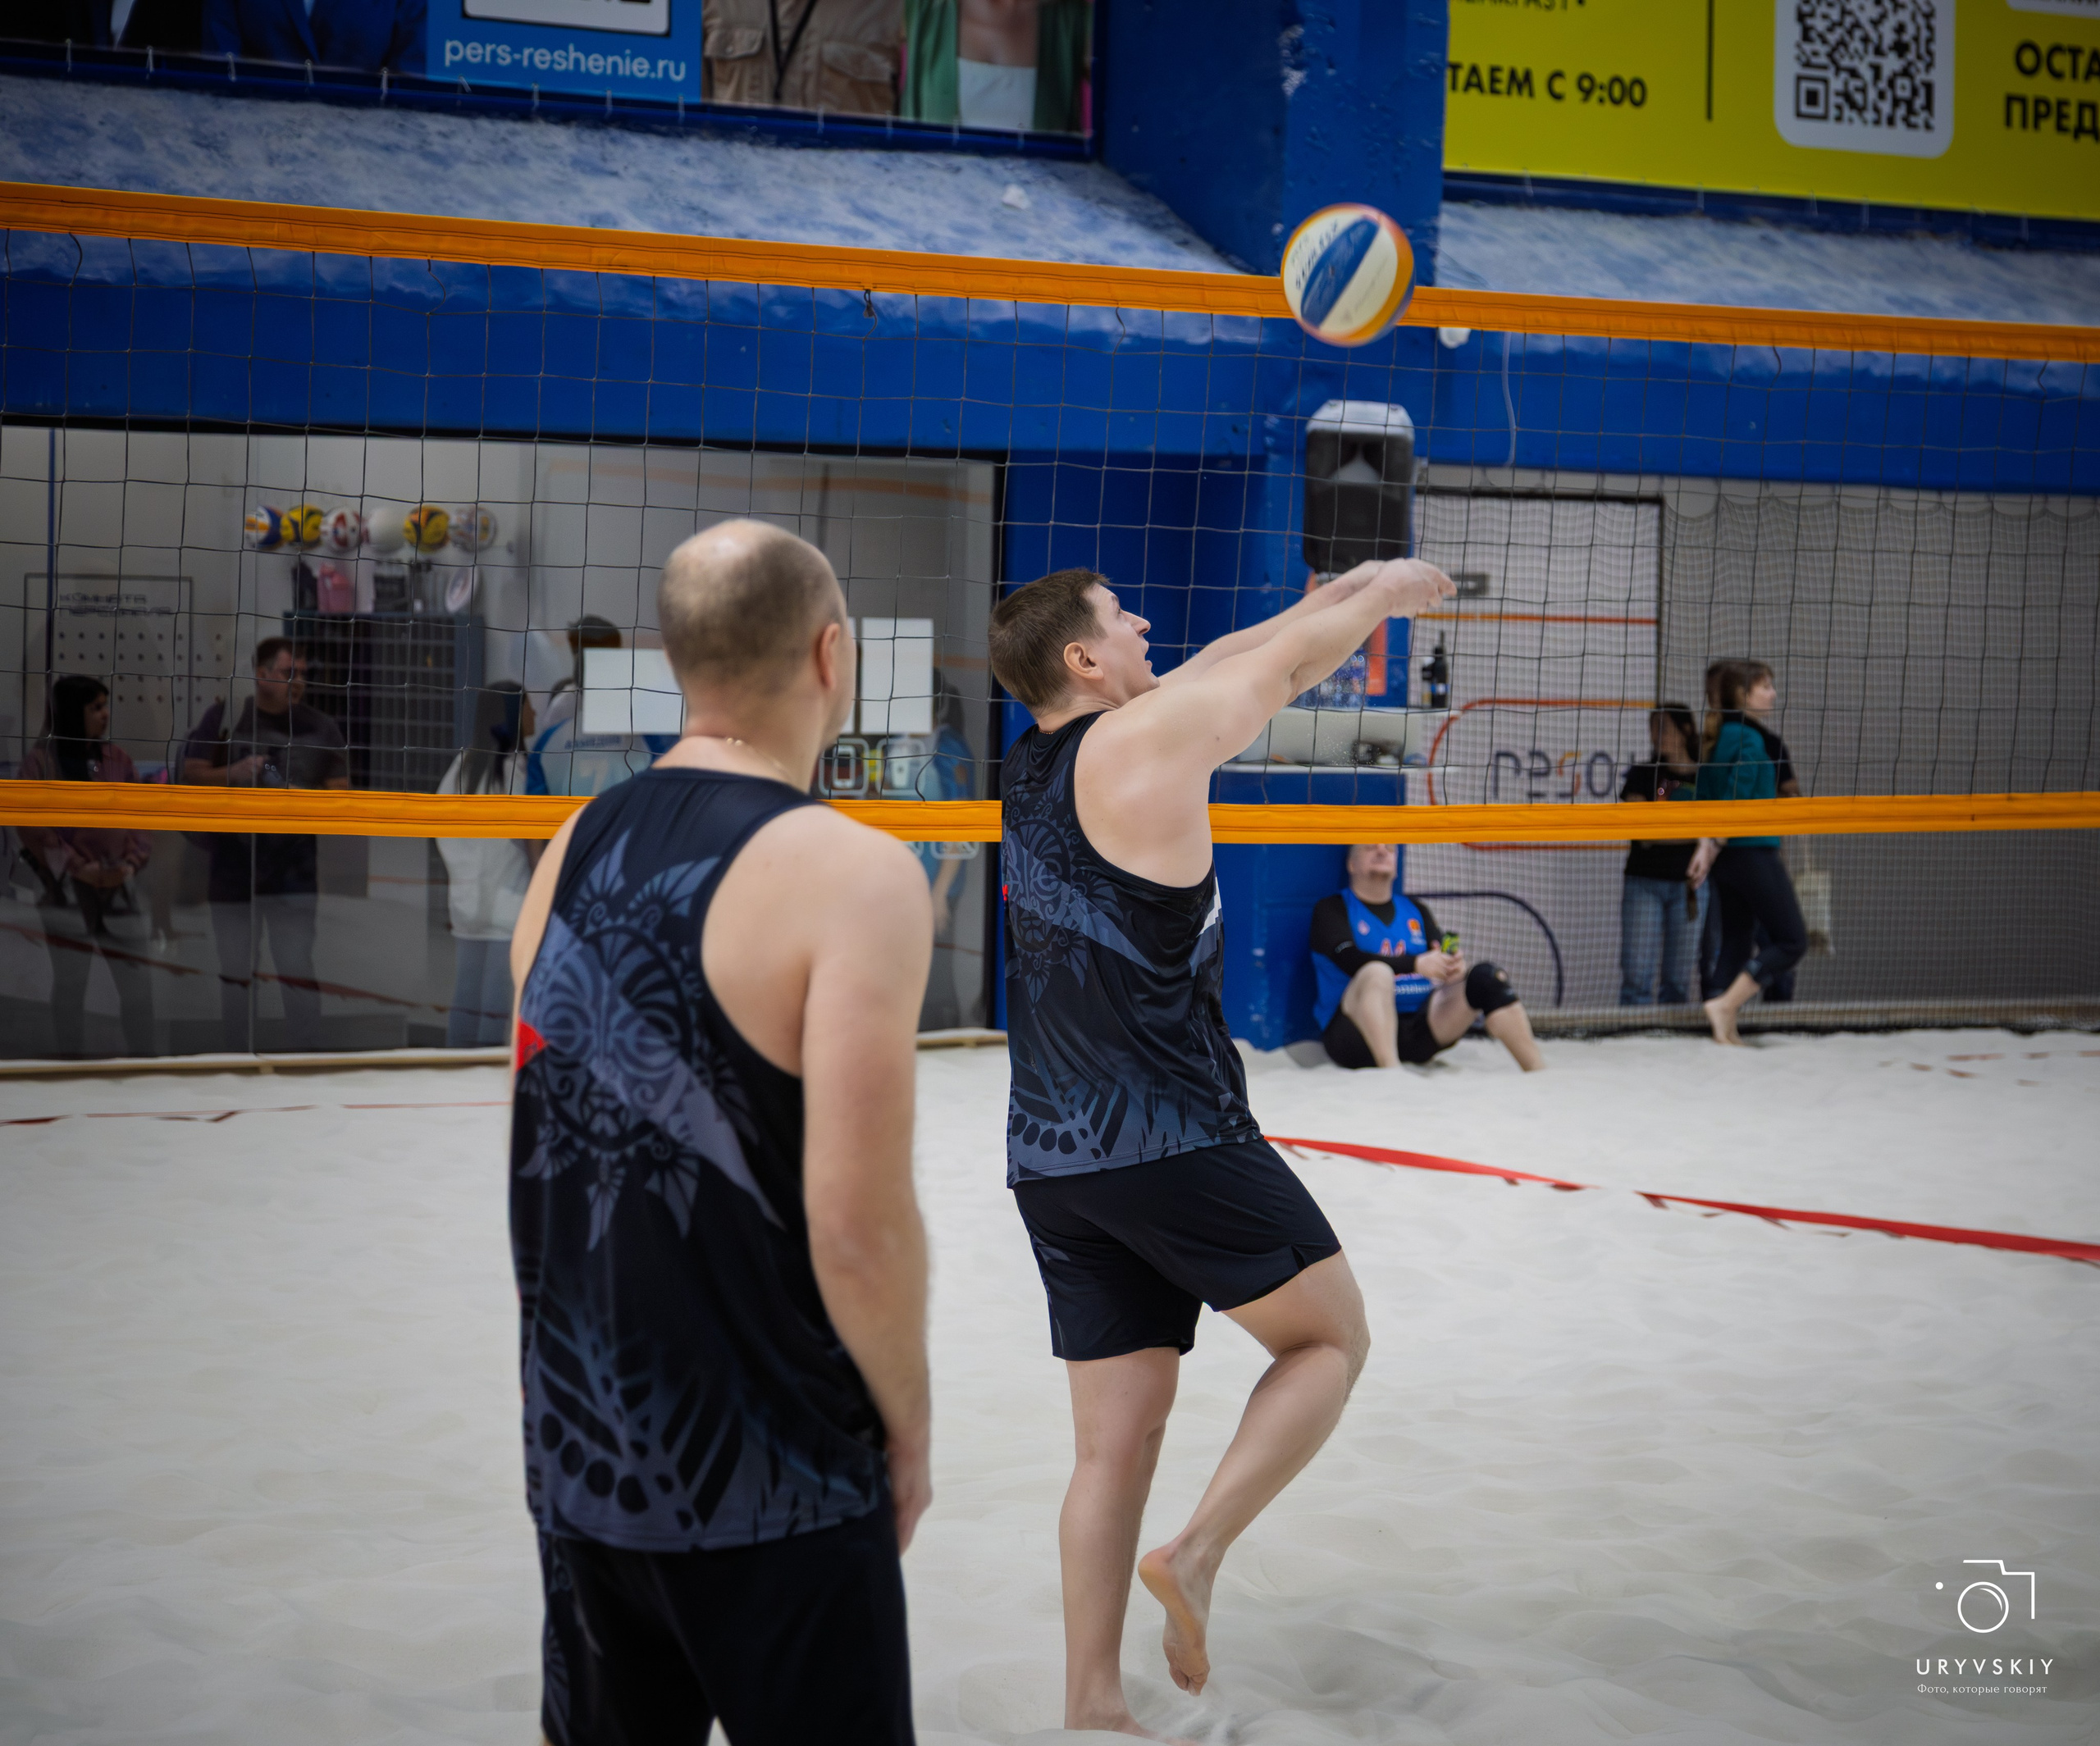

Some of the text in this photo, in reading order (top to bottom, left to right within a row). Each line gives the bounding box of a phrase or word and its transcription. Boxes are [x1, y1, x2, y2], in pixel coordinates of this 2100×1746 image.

[445, 39, 686, 81] pers-reshenie.ru
[1576, 71, 1647, 107] 9:00
[2005, 93, 2099, 143] ПРЕД
